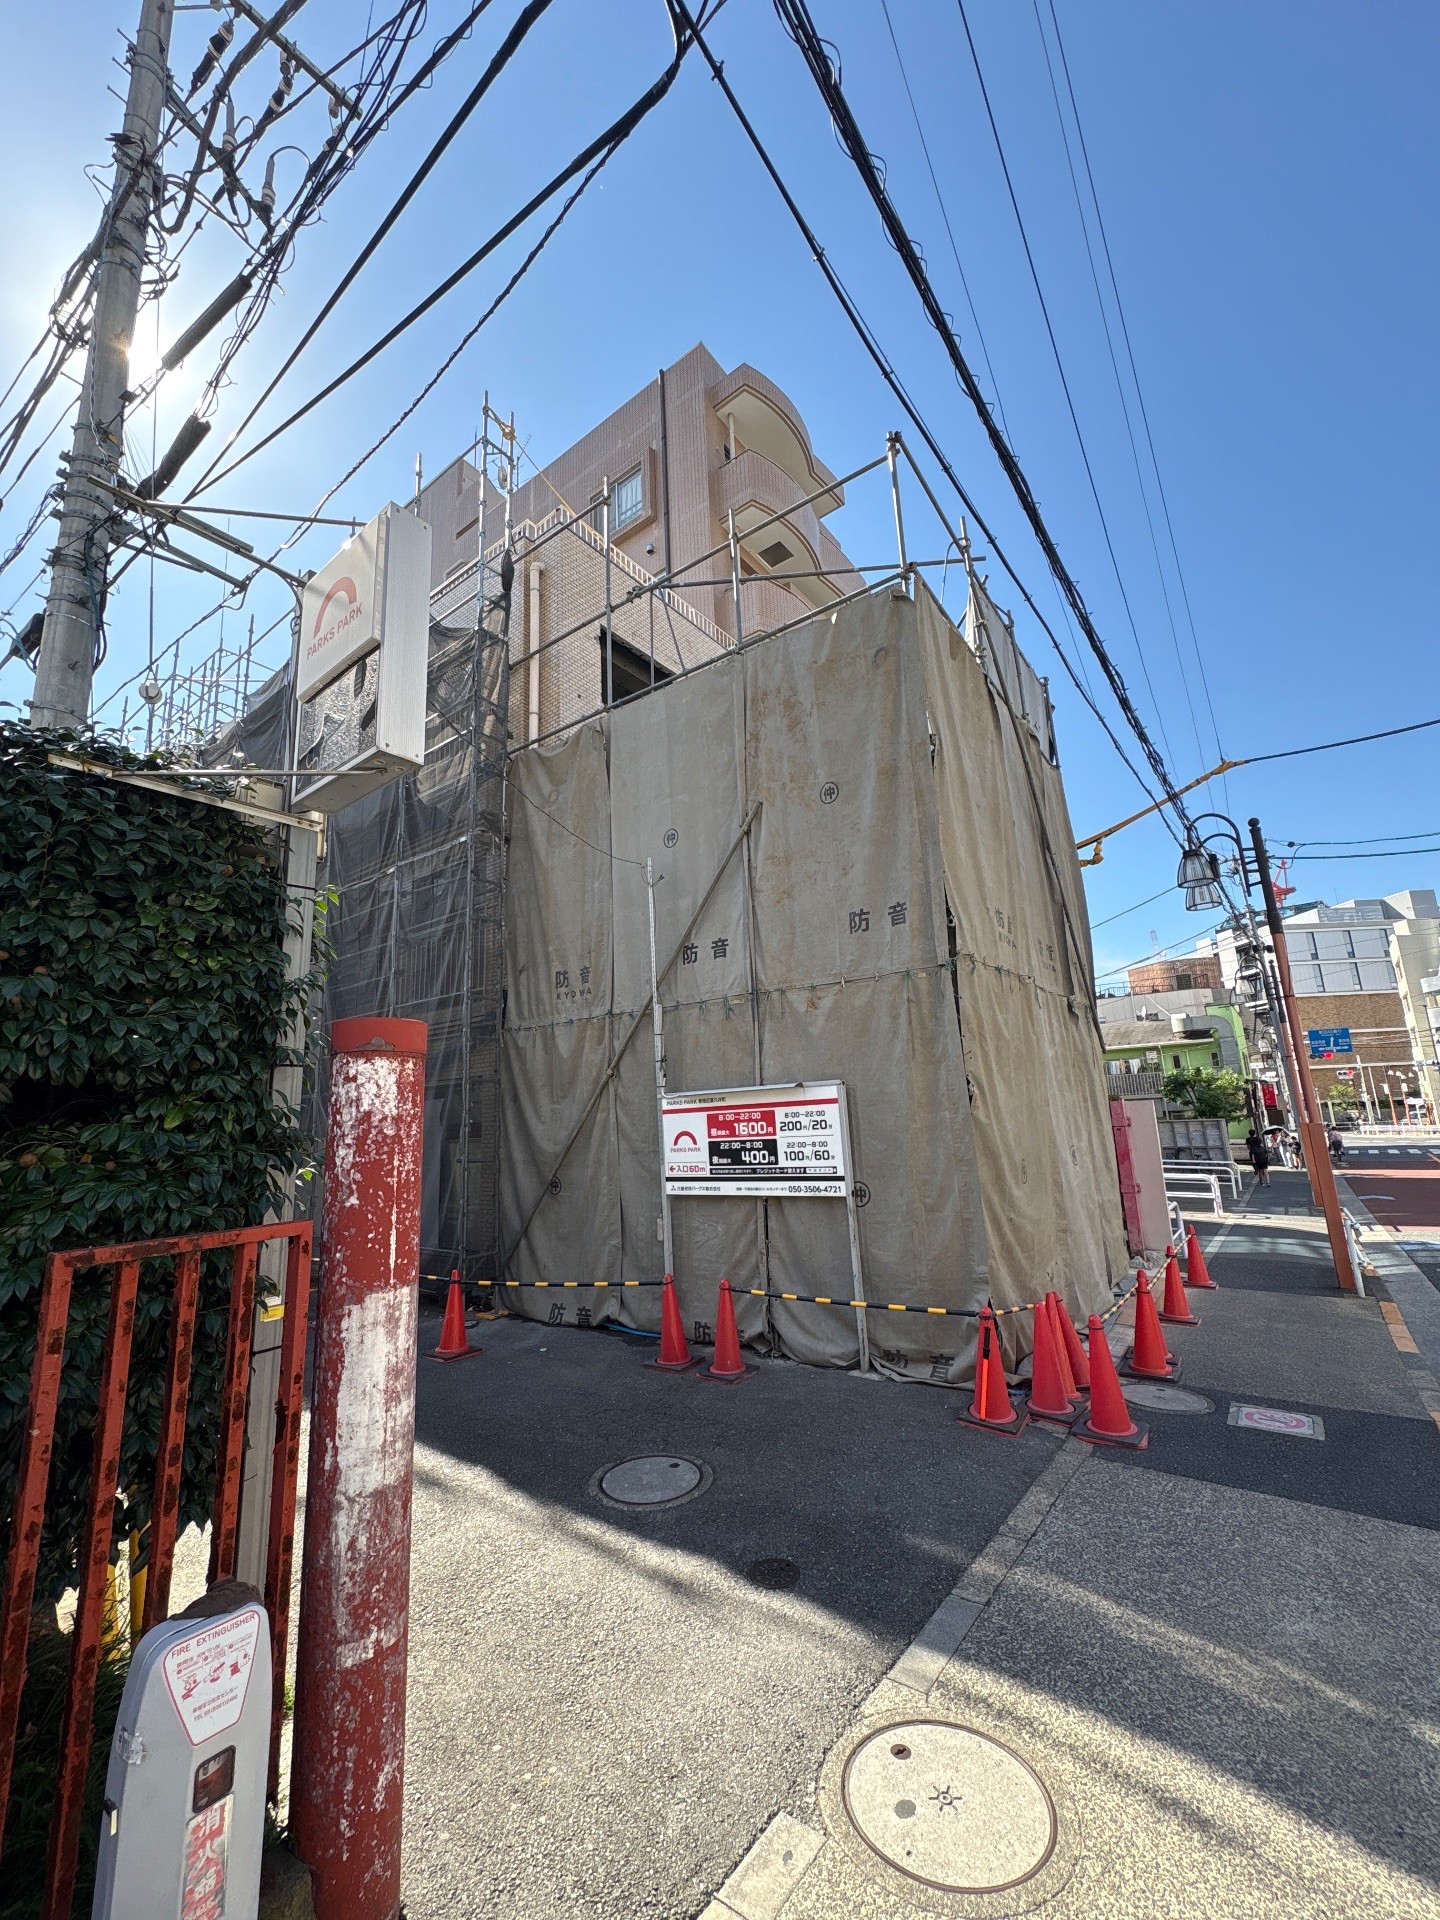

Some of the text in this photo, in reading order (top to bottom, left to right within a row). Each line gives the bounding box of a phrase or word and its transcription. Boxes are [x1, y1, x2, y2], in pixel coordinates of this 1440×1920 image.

[307, 602, 363, 660] PARKS PARK
[849, 901, 908, 934] 防音
[683, 937, 729, 965] 防音
[555, 965, 590, 989] 防音
[557, 987, 592, 1000] KYOWA
[548, 1303, 592, 1326] 防音
[171, 1644, 191, 1659] FIRE
[196, 1613, 256, 1647] EXTINGUISHER
